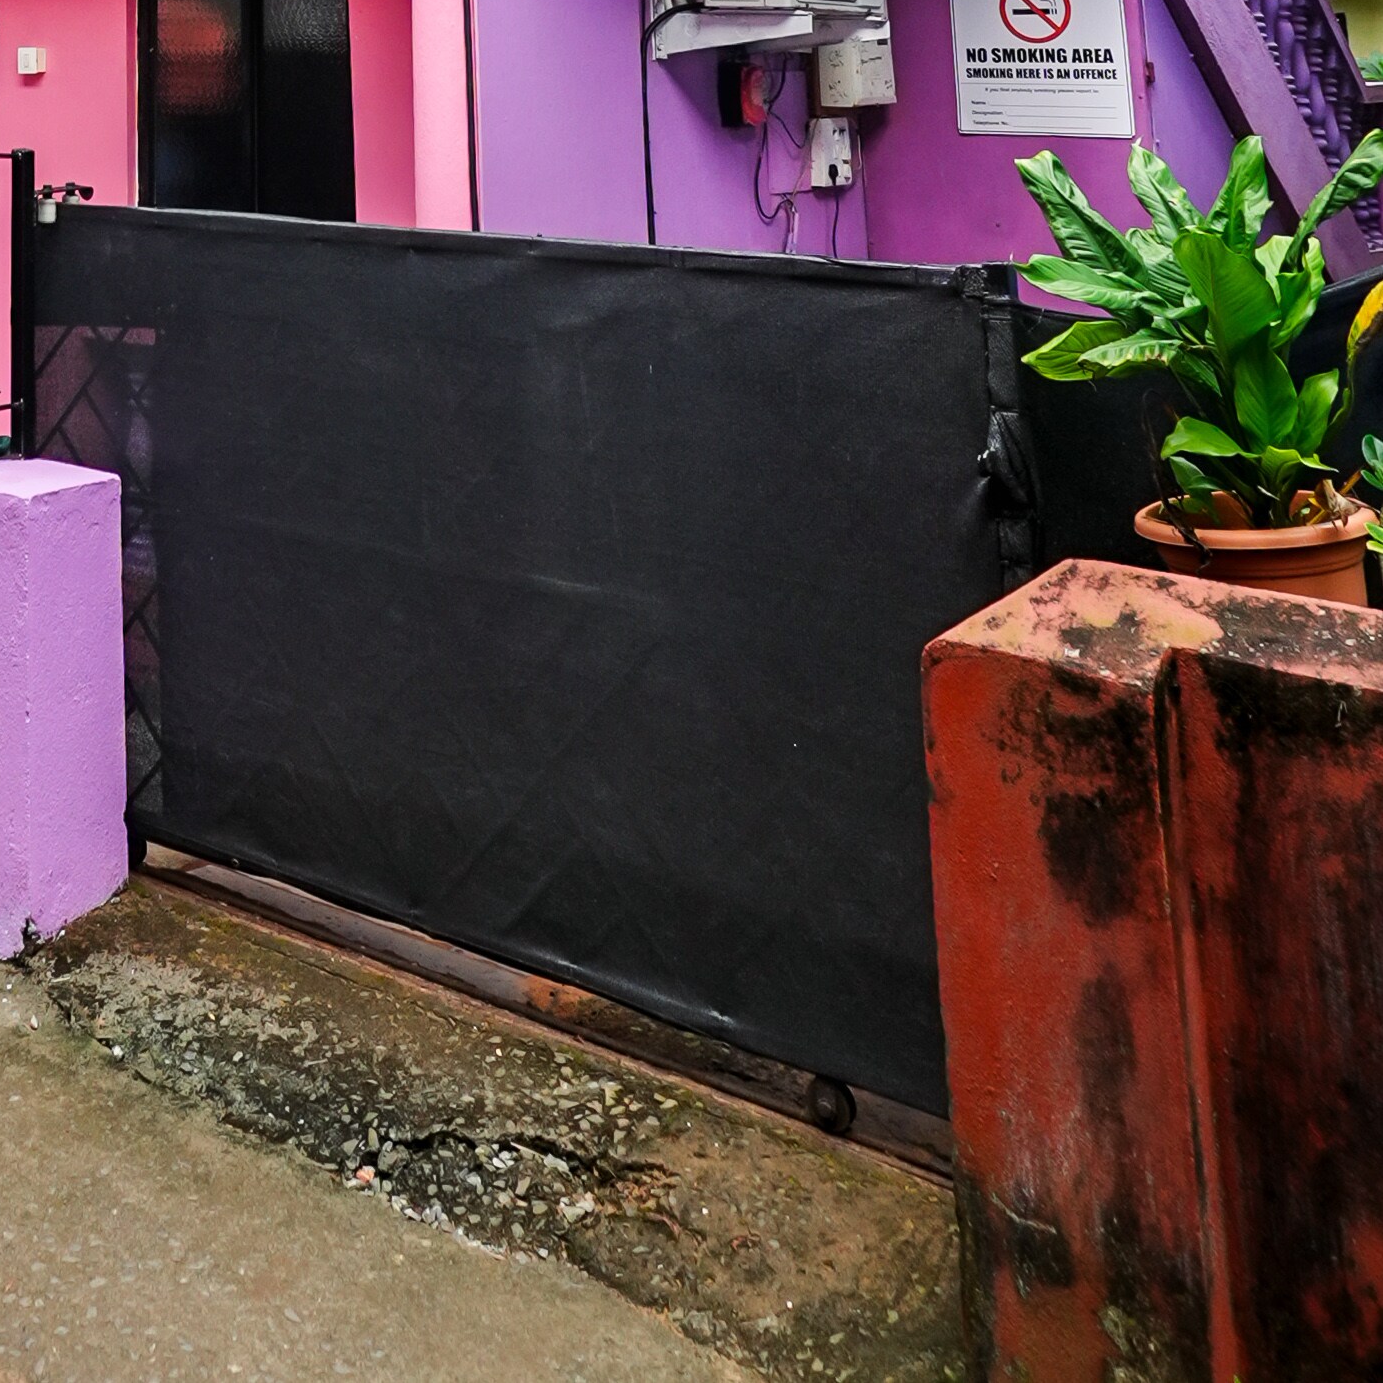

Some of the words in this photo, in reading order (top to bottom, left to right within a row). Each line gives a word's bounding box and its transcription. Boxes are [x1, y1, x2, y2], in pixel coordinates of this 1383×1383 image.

[966, 48, 988, 63] NO
[991, 48, 1068, 64] SMOKING
[1071, 48, 1114, 64] AREA
[966, 68, 1014, 79] SMOKING
[1016, 68, 1041, 79] HERE
[1043, 69, 1054, 79] IS
[1056, 69, 1071, 80] AN
[1073, 69, 1118, 81] OFFENCE
